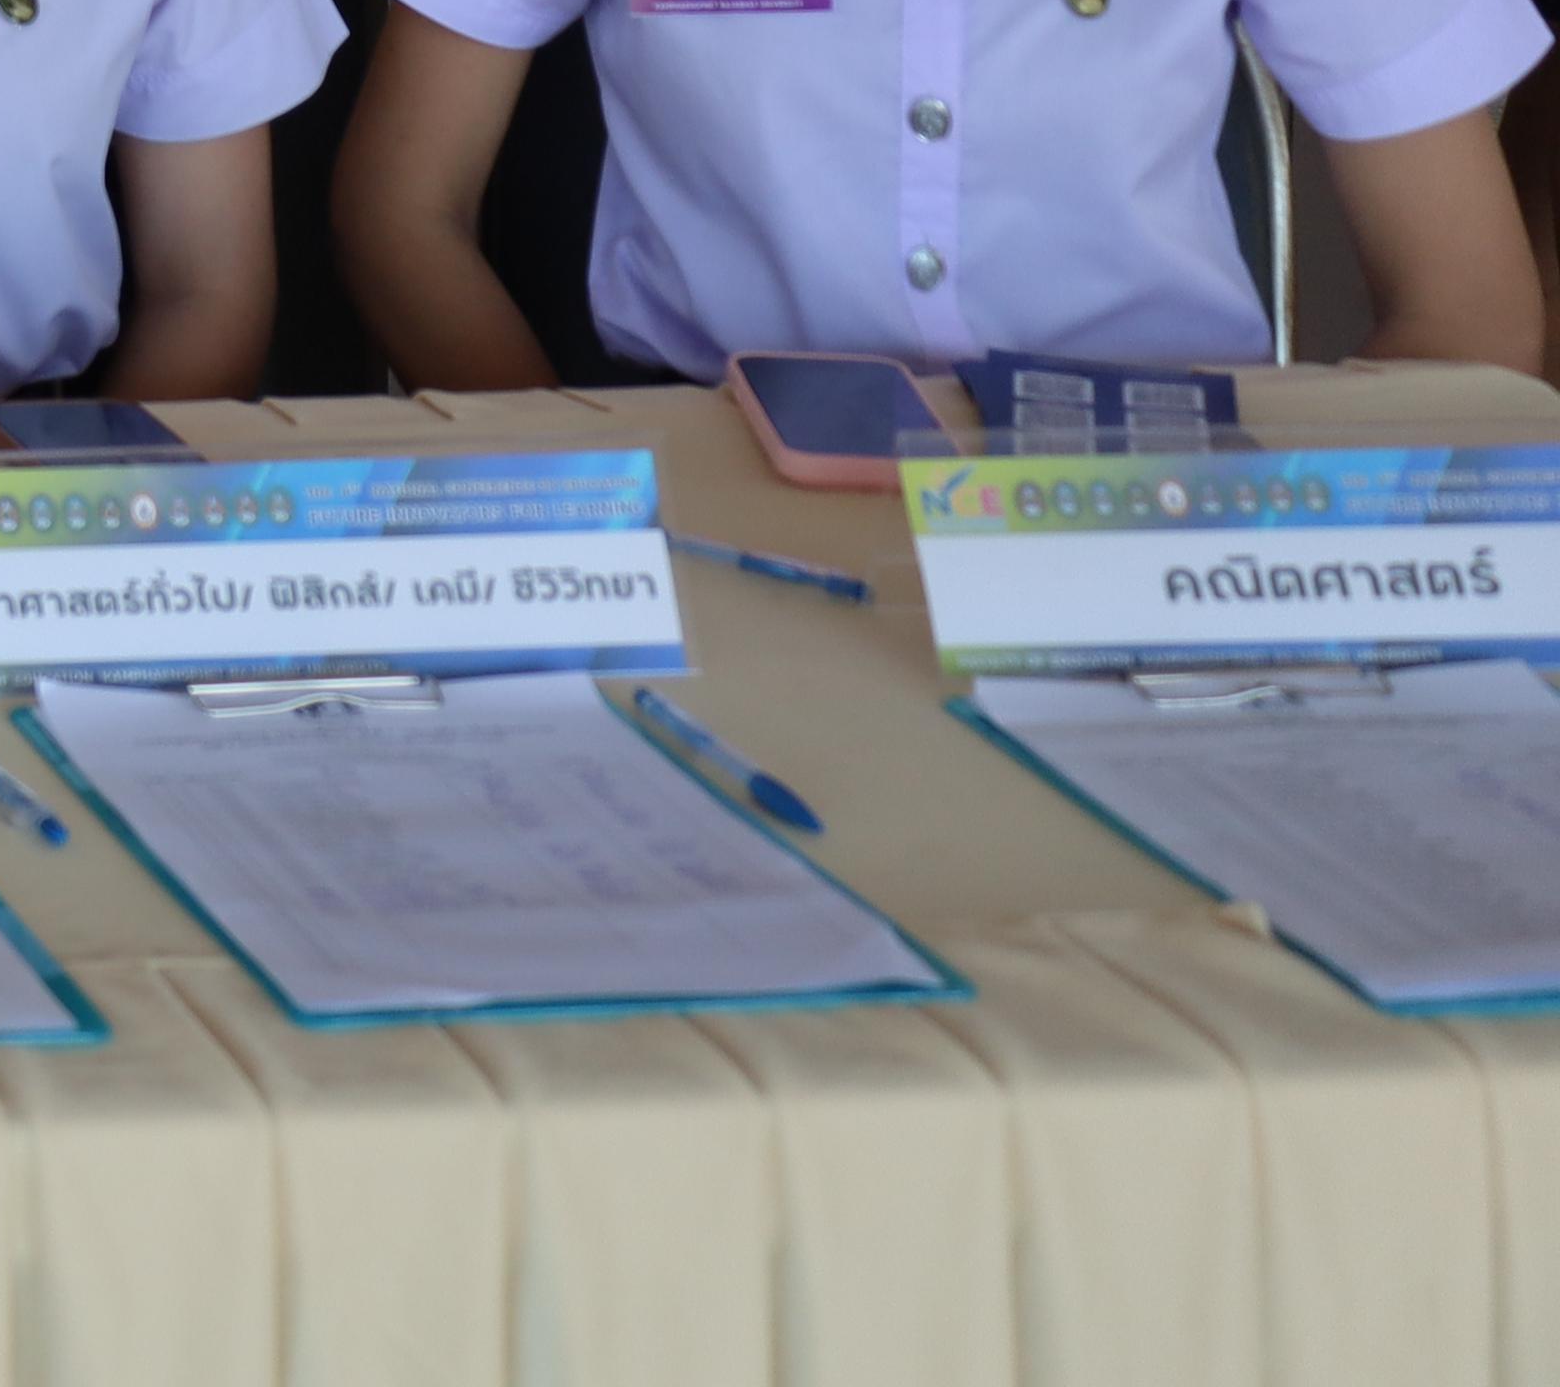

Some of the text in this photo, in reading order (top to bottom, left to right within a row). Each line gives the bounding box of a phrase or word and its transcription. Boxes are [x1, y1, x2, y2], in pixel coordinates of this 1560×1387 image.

[269, 570, 396, 610] ฟิสิกส์/
[412, 568, 496, 606] เคมี/
[1163, 545, 1501, 602] คณิตศาสตร์
